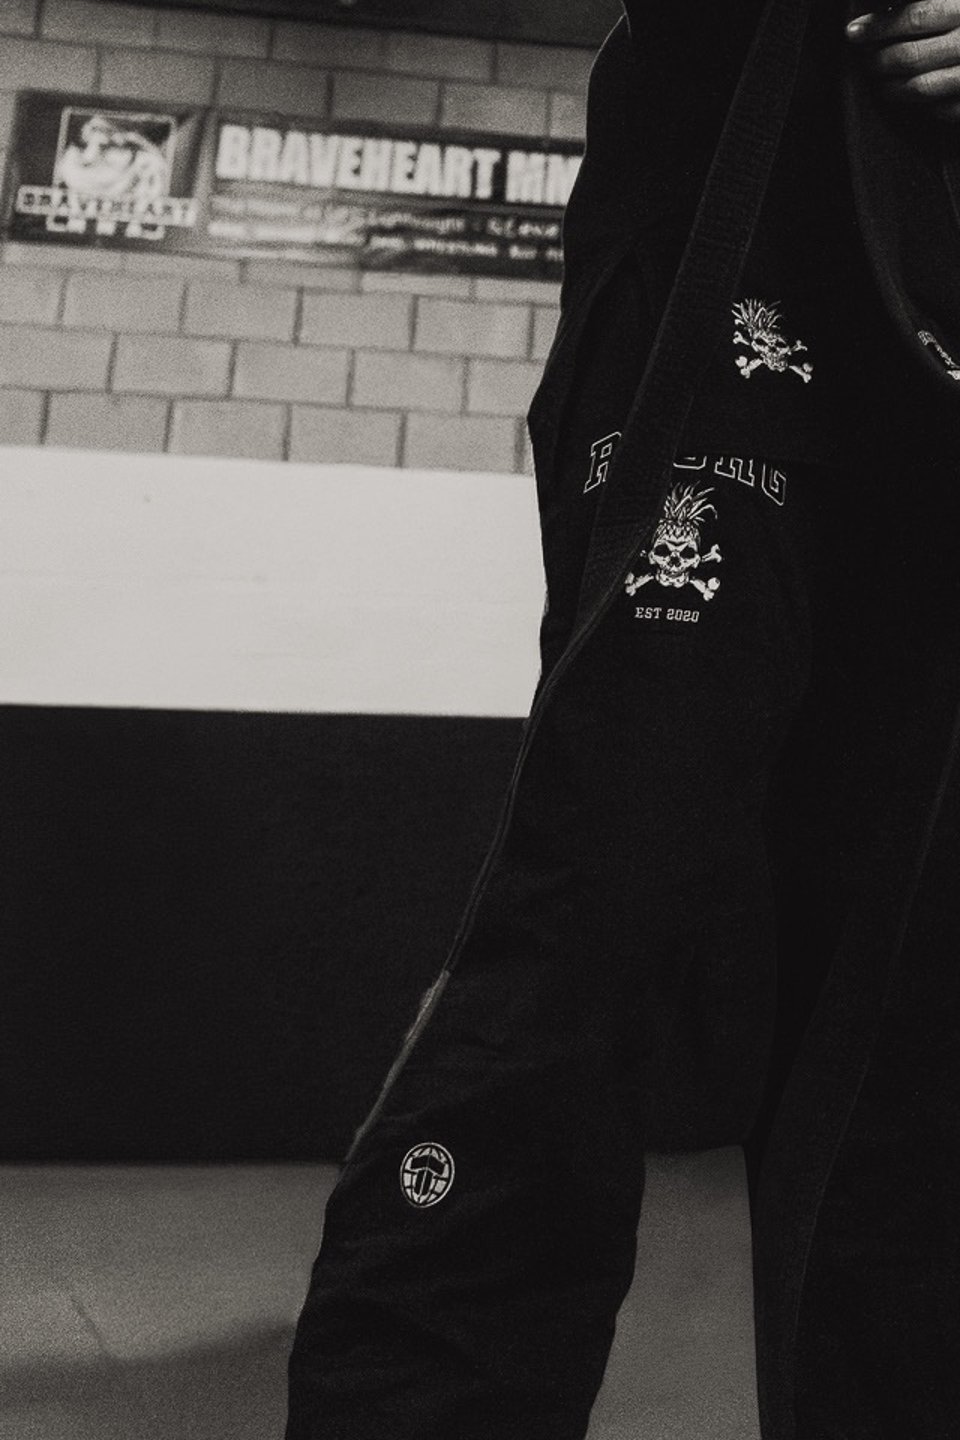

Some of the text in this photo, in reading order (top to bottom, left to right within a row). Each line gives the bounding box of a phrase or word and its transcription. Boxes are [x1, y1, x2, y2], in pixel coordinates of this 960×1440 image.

[215, 124, 501, 200] BRAVEHEART
[634, 606, 700, 623] EST 2020
